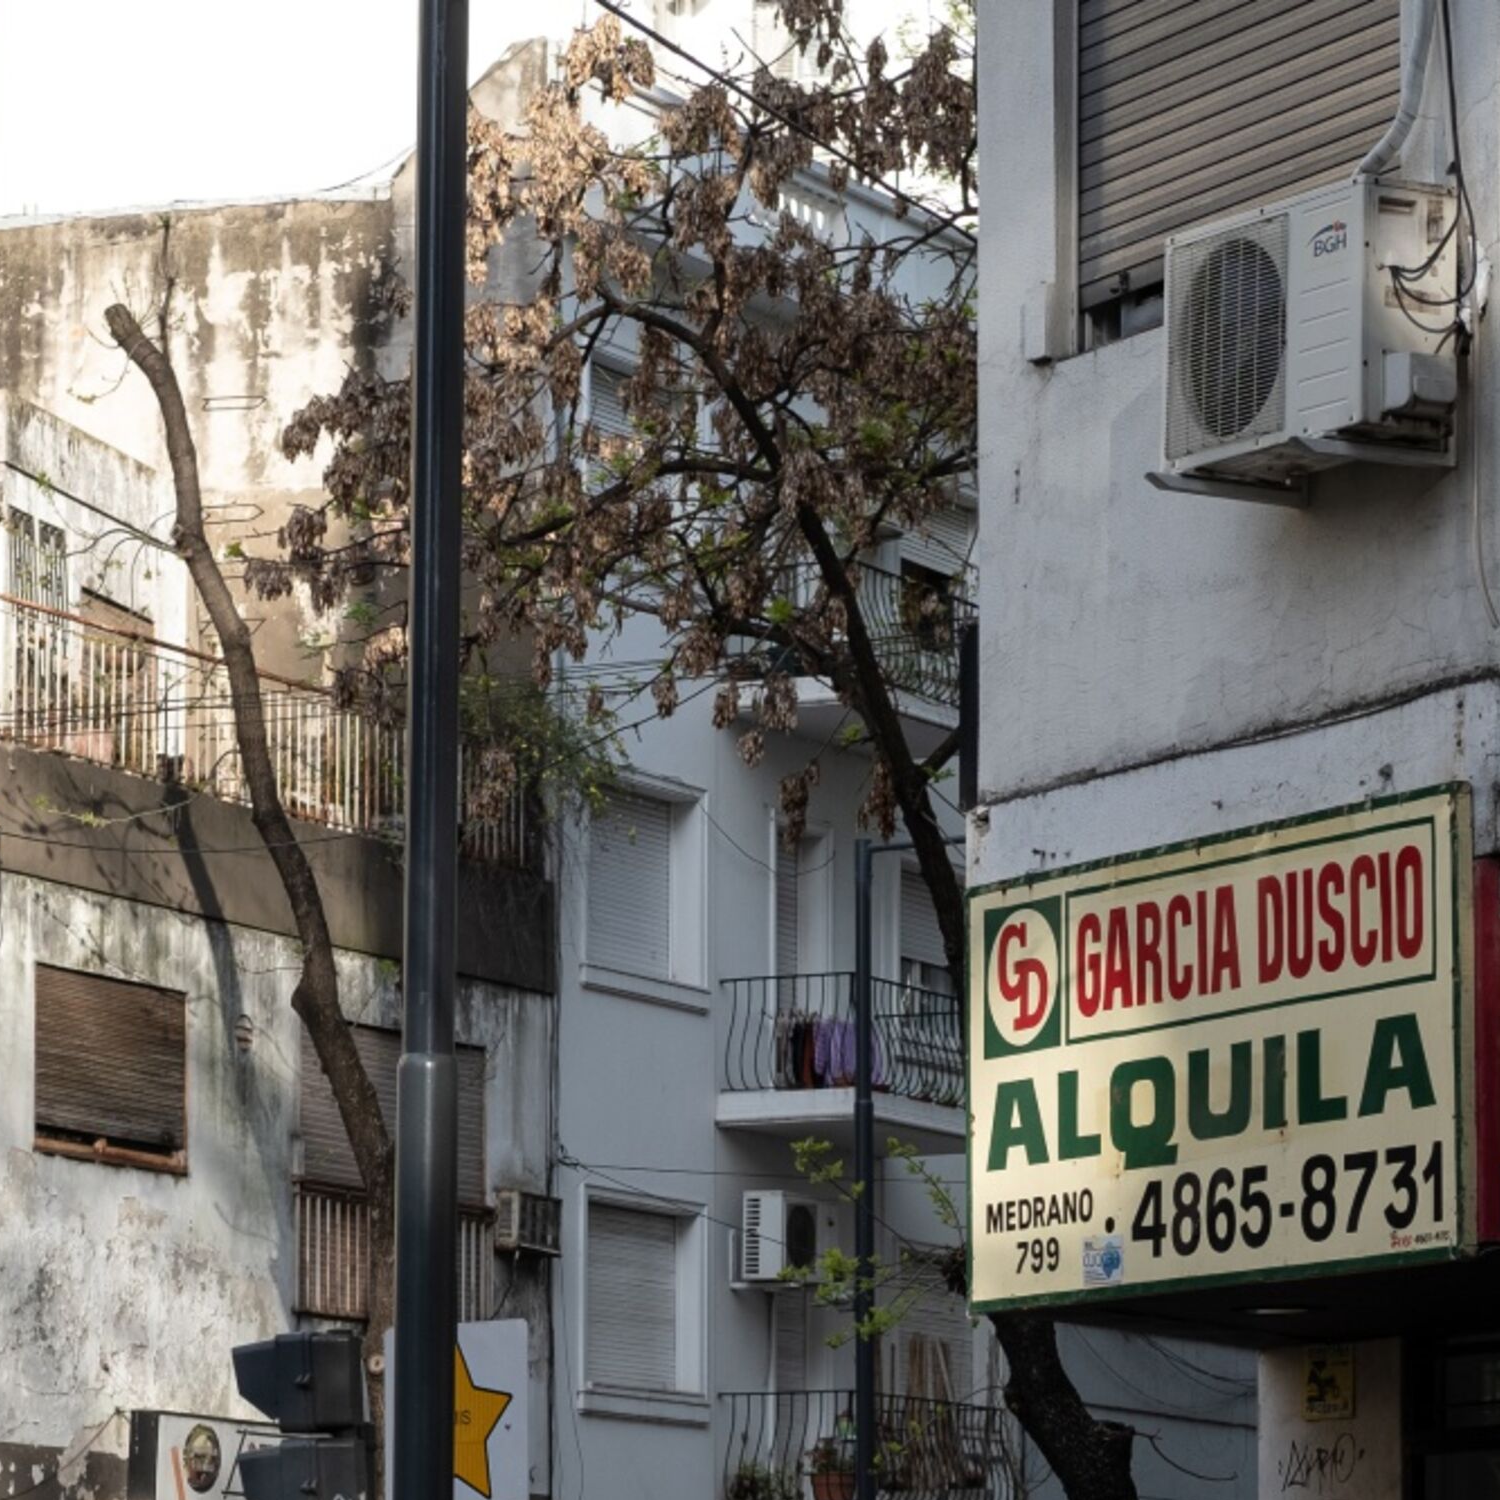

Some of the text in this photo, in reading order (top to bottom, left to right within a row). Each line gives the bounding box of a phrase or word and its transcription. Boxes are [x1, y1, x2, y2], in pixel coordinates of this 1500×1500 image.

[1313, 232, 1347, 257] BGH
[1076, 845, 1424, 1018] GARCIA DUSCIO
[986, 1012, 1437, 1172] ALQUILA
[986, 1187, 1094, 1234] MEDRANO
[1131, 1140, 1444, 1257] 4865-8731
[1015, 1237, 1061, 1275] 799
